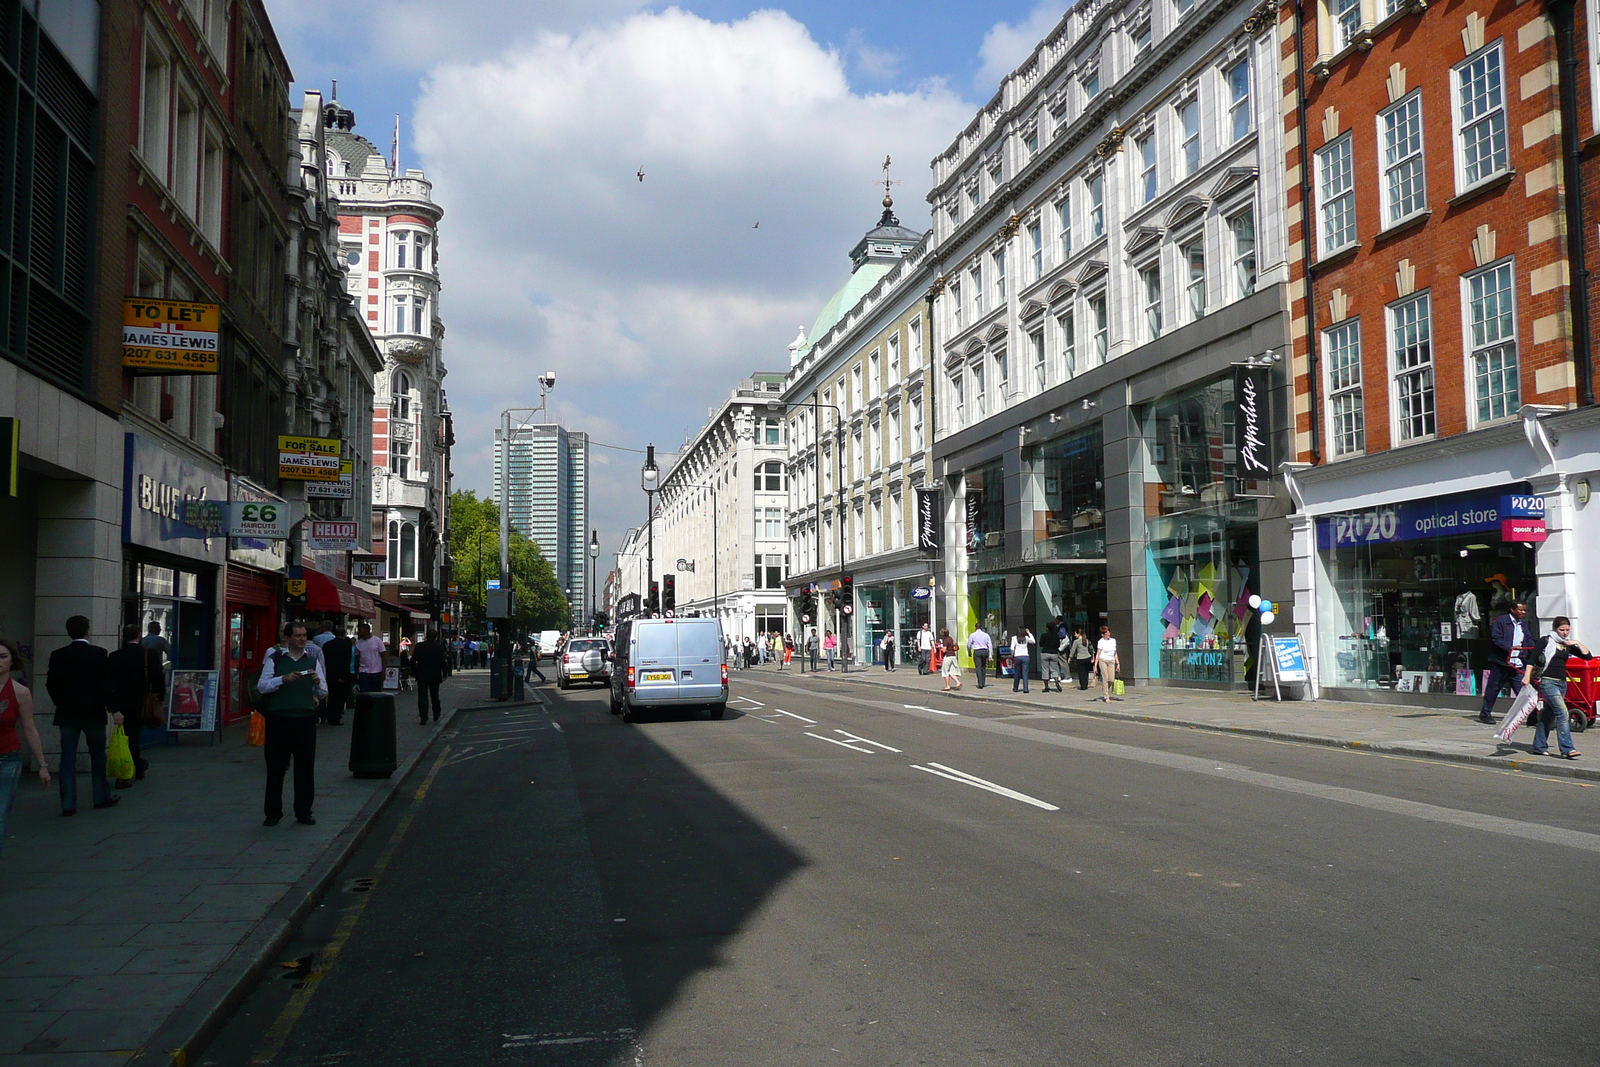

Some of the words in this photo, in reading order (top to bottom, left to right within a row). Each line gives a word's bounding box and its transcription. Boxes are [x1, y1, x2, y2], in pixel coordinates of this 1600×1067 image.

[132, 305, 160, 319] TO
[168, 308, 205, 322] LET
[123, 333, 168, 346] JAMES
[172, 337, 215, 349] LEWIS
[156, 350, 177, 360] 631
[183, 352, 215, 363] 4565
[1240, 376, 1268, 472] Paperchase
[285, 441, 306, 450] FOR
[310, 444, 335, 453] SALE
[281, 457, 310, 465] JAMES
[139, 474, 180, 521] BLUE
[242, 504, 276, 522] £6
[921, 494, 938, 548] Paperchase
[1415, 512, 1458, 534] optical
[1462, 508, 1497, 525] store
[316, 524, 354, 537] HELLO!
[360, 563, 379, 575] PRET
[1187, 653, 1203, 665] ART
[1204, 653, 1216, 665] ON
[1217, 653, 1223, 666] 2
